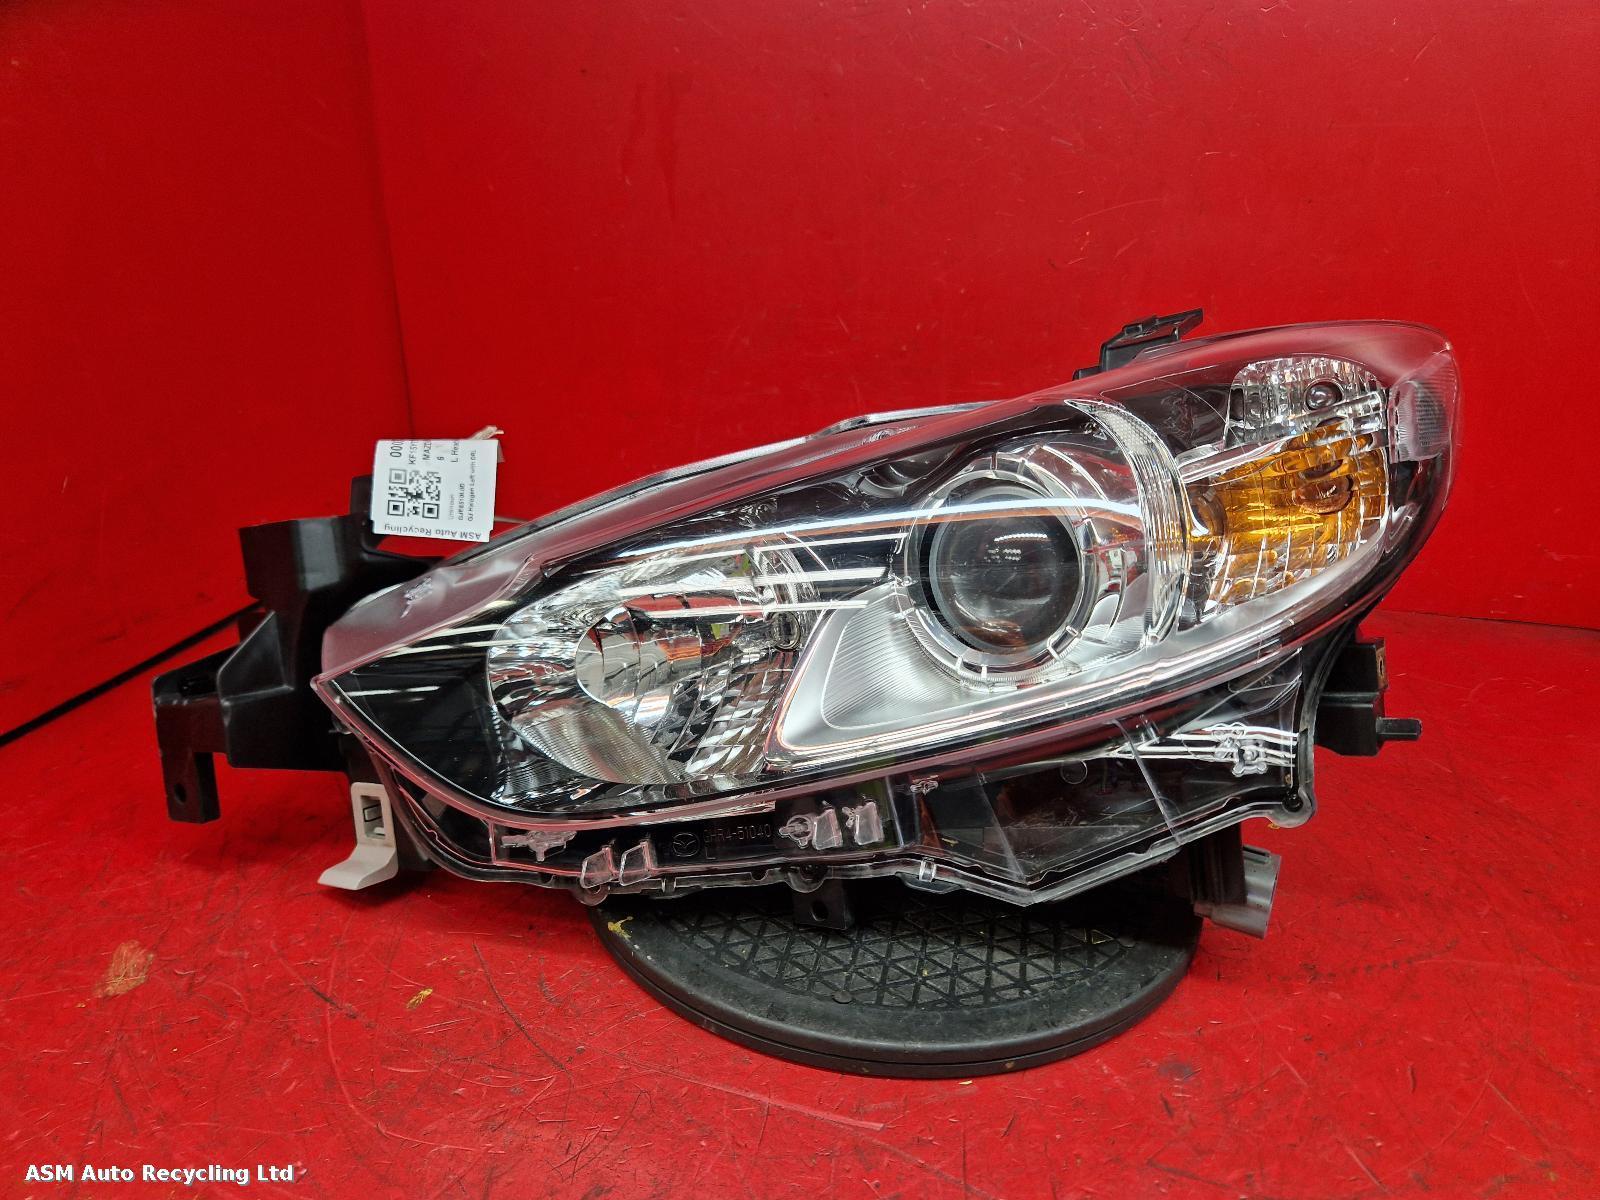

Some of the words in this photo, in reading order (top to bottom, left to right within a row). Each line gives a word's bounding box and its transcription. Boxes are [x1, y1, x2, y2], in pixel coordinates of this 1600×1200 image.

[384, 523, 432, 536] Recycling
[435, 529, 457, 538] Auto
[461, 531, 481, 540] ASM
